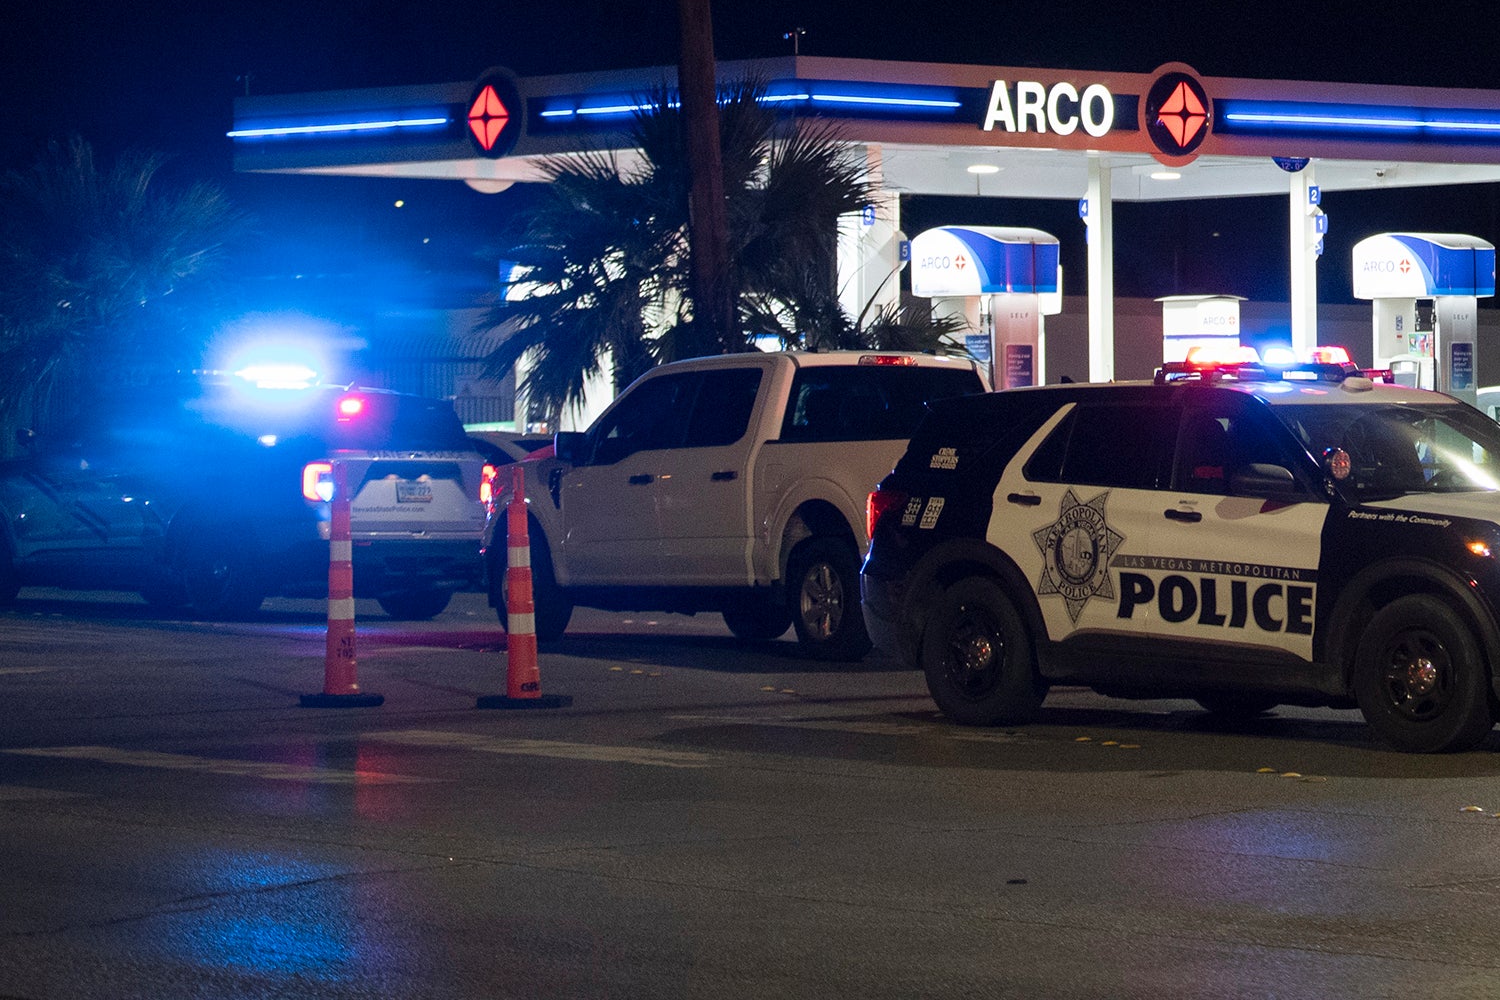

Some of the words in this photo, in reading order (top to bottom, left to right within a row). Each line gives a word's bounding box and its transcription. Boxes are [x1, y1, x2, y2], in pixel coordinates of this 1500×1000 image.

[983, 79, 1115, 137] ARCO
[1311, 189, 1317, 202] 2
[1080, 200, 1087, 213] 4
[921, 256, 951, 269] ARCO
[1363, 260, 1395, 273] ARCO
[1203, 316, 1225, 325] ARCO
[1348, 510, 1377, 520] Partners
[1378, 513, 1395, 521] with
[1409, 515, 1452, 528] Community
[1047, 507, 1107, 554] METROPOLITAN
[1124, 557, 1146, 567] LAS
[1152, 558, 1193, 570] VEGAS
[1200, 563, 1301, 579] METROPOLITAN
[1057, 581, 1097, 597] POLICE
[1117, 572, 1314, 635] POLICE
